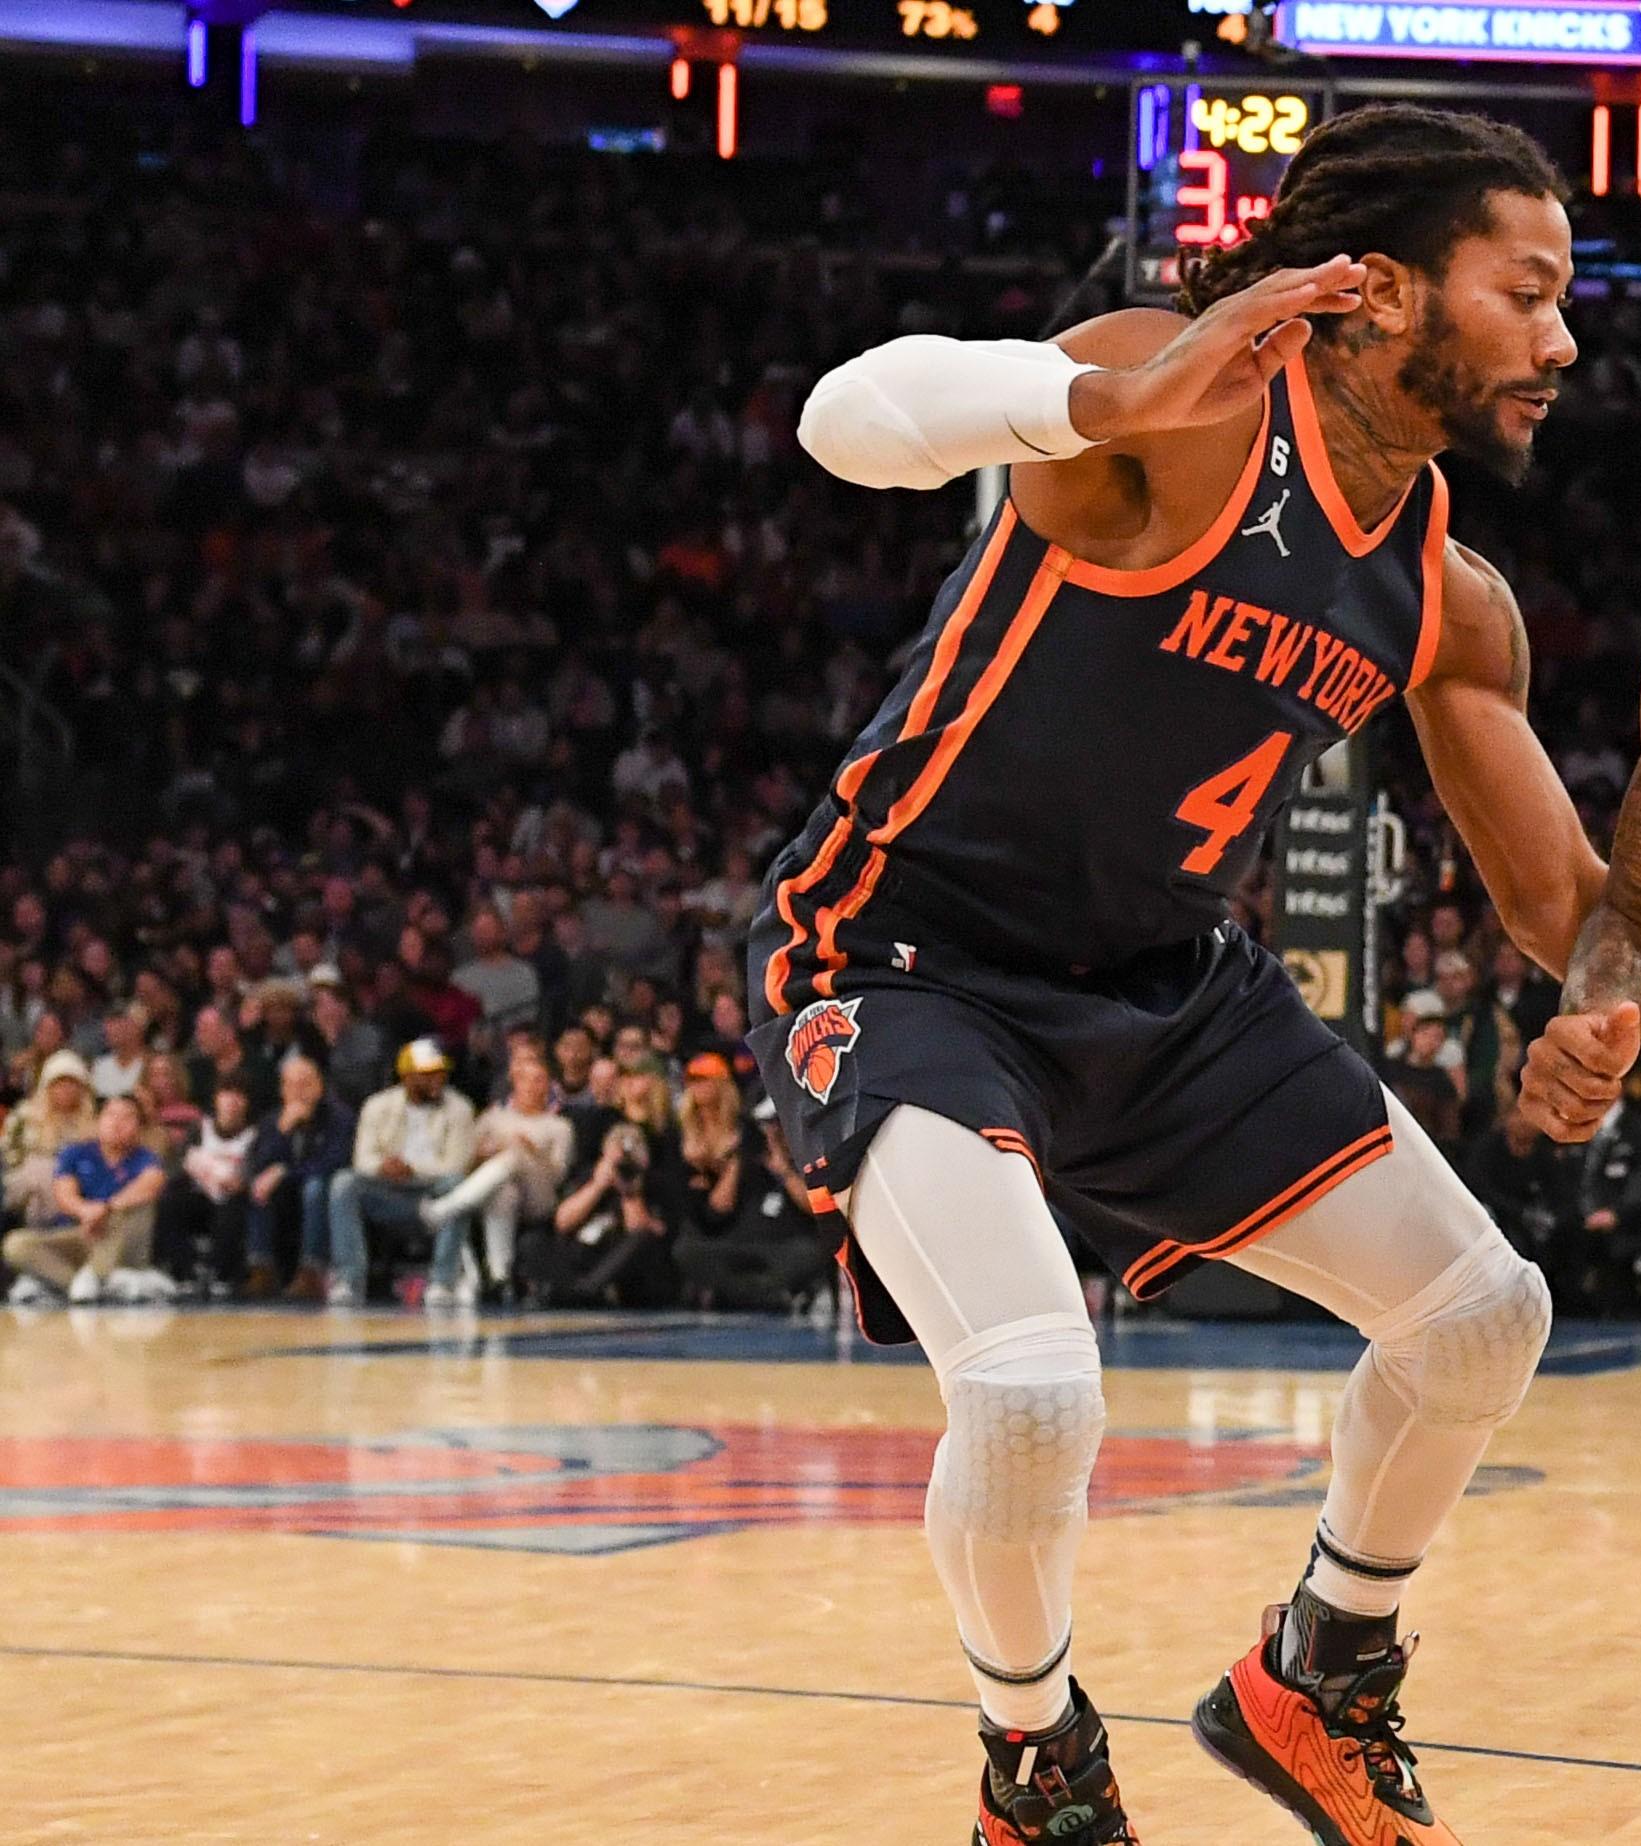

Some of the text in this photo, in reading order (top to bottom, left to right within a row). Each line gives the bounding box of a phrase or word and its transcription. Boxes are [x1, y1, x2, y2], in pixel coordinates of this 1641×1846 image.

[1296, 2, 1384, 41] NEW
[1386, 7, 1489, 44] YORK
[1492, 11, 1632, 50] KNICKS
[1191, 94, 1308, 154] 4:22
[1269, 434, 1291, 478] 6
[1159, 588, 1397, 737] NEW YORK
[1174, 730, 1294, 876] 4
